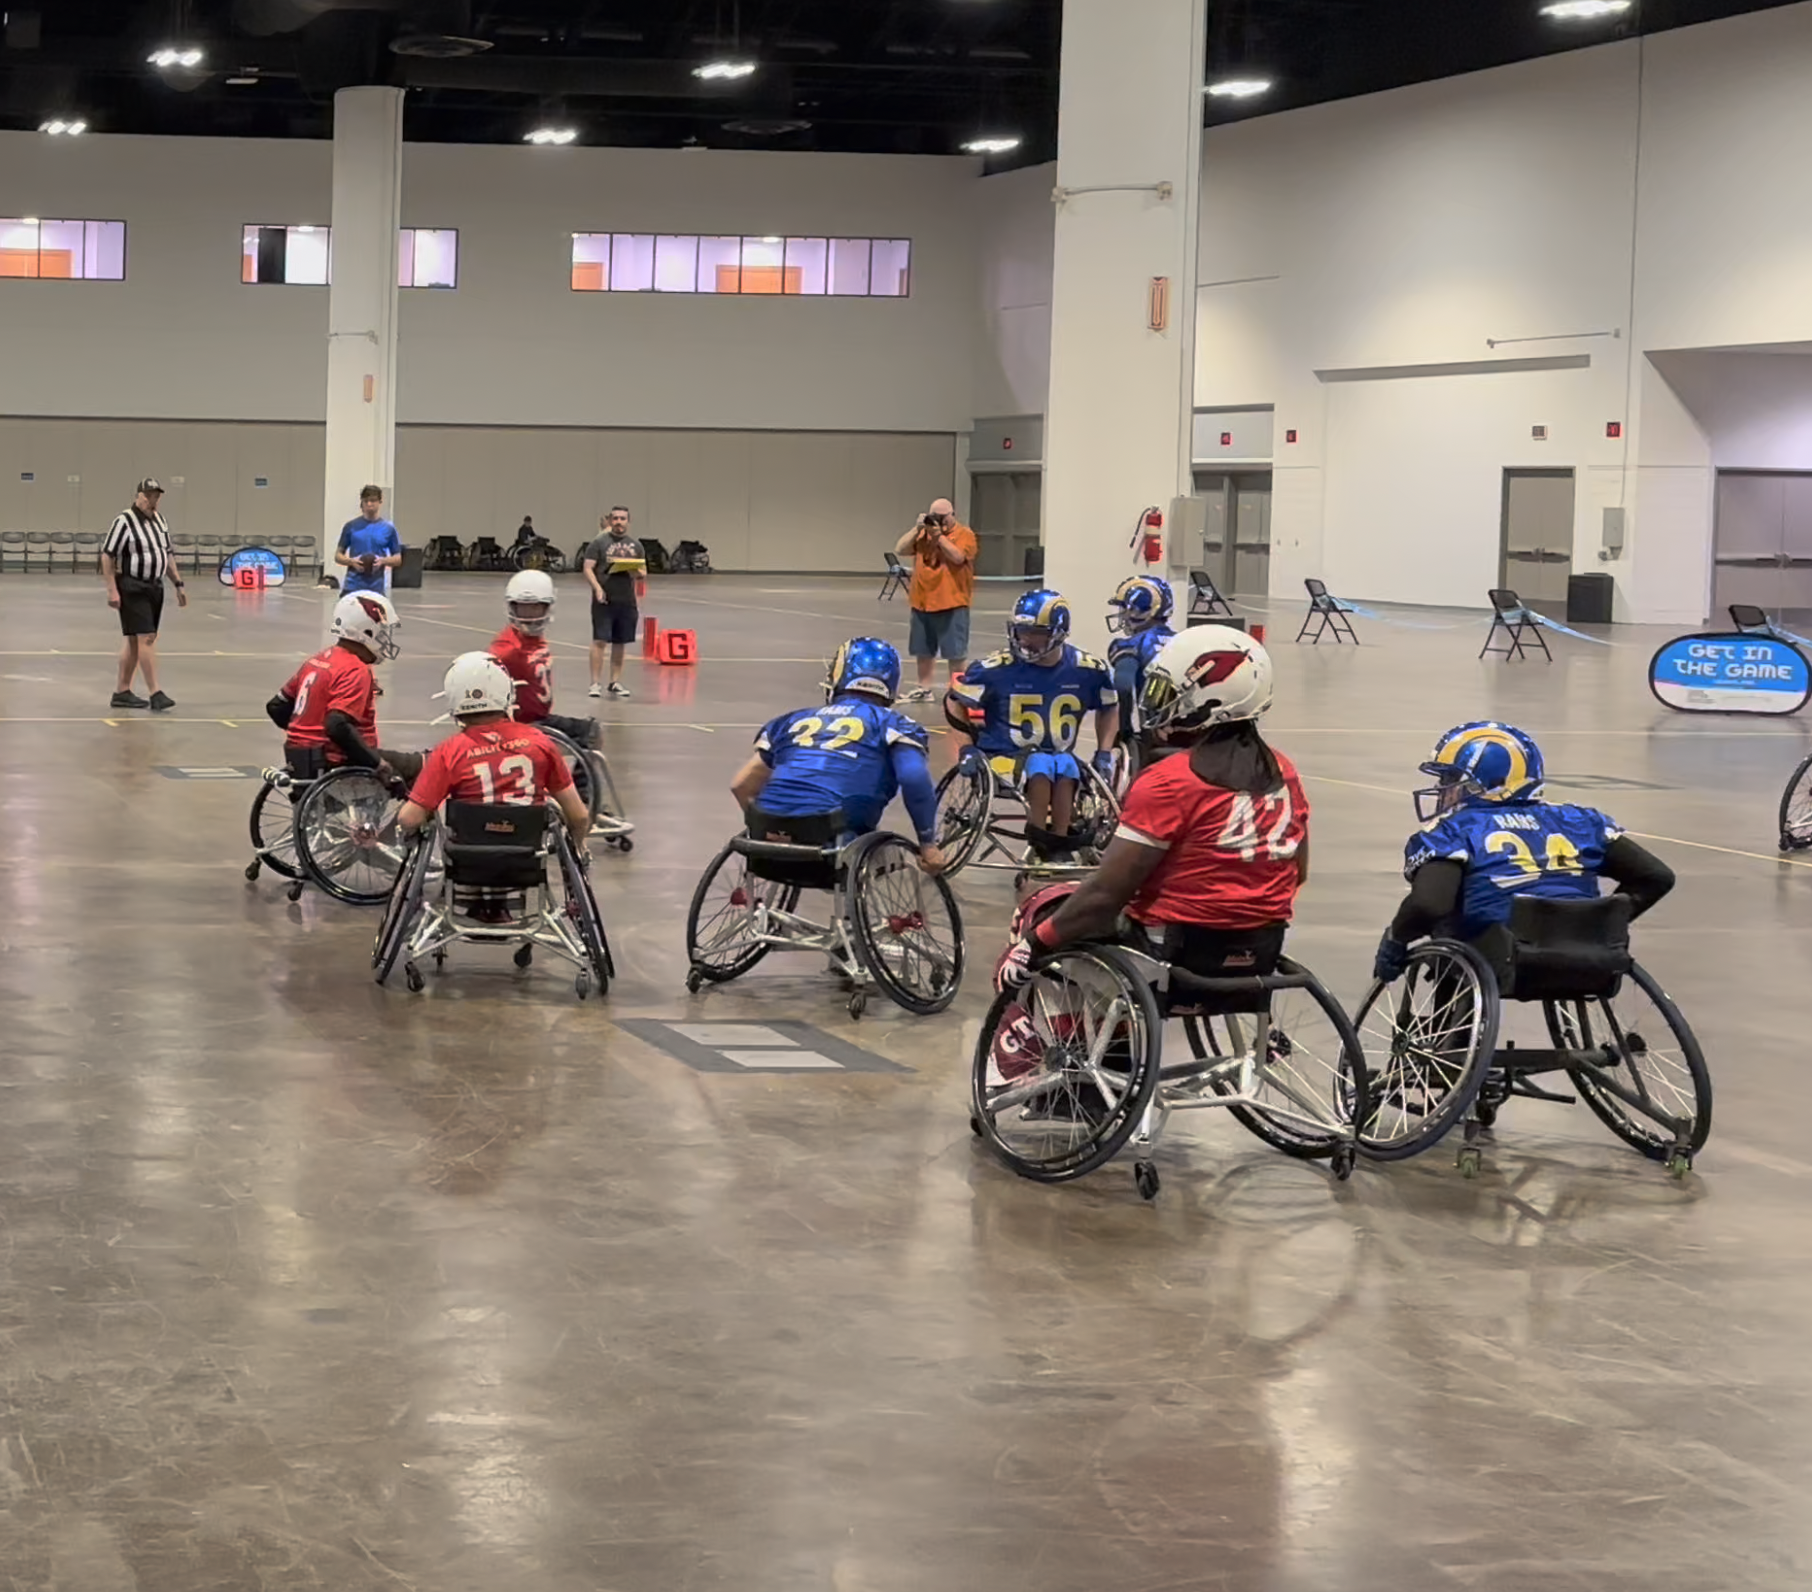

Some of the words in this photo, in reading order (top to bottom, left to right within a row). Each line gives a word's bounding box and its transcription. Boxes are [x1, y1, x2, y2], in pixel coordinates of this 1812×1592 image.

[241, 570, 253, 586] G
[668, 633, 689, 659] G
[1689, 643, 1735, 659] GET
[1743, 646, 1772, 660] IN
[1673, 658, 1717, 676] THE
[1725, 664, 1793, 680] GAME
[1009, 694, 1081, 751] 56
[473, 754, 535, 806] 13
[1217, 785, 1299, 862] 42
